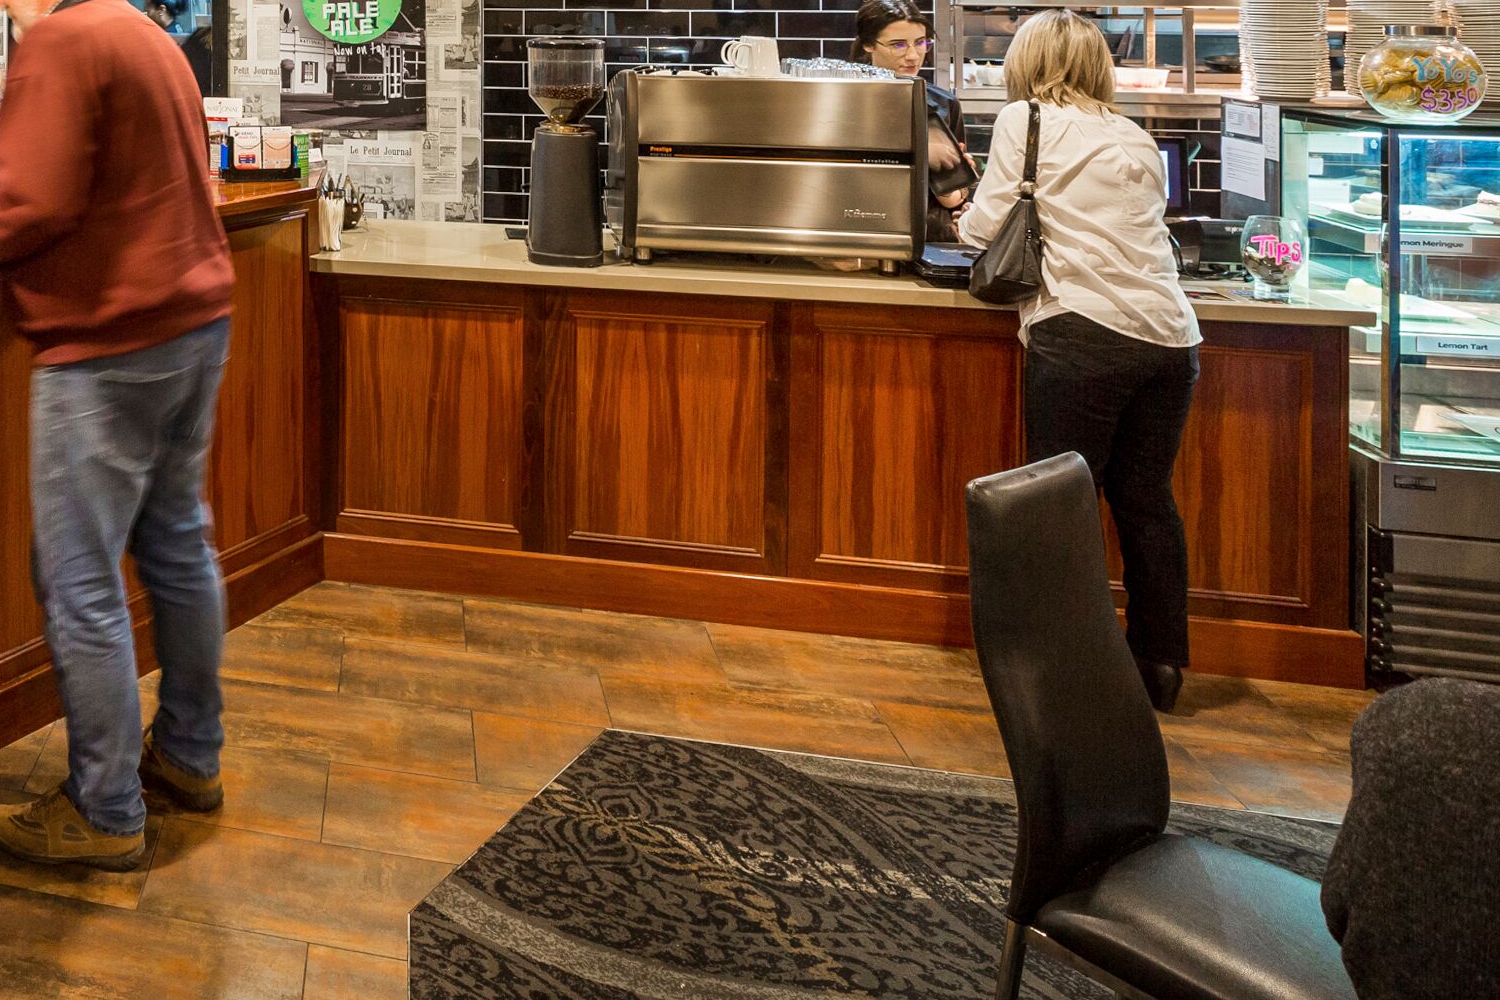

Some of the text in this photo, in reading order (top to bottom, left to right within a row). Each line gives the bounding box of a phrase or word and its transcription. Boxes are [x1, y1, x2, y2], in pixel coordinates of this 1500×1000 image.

[323, 1, 379, 20] PALE
[330, 18, 373, 37] ALE
[334, 44, 353, 55] Now
[356, 46, 367, 55] on
[233, 66, 280, 76] Petit Journal
[350, 146, 412, 156] Le Petit Journal
[1422, 240, 1464, 248] Meringue
